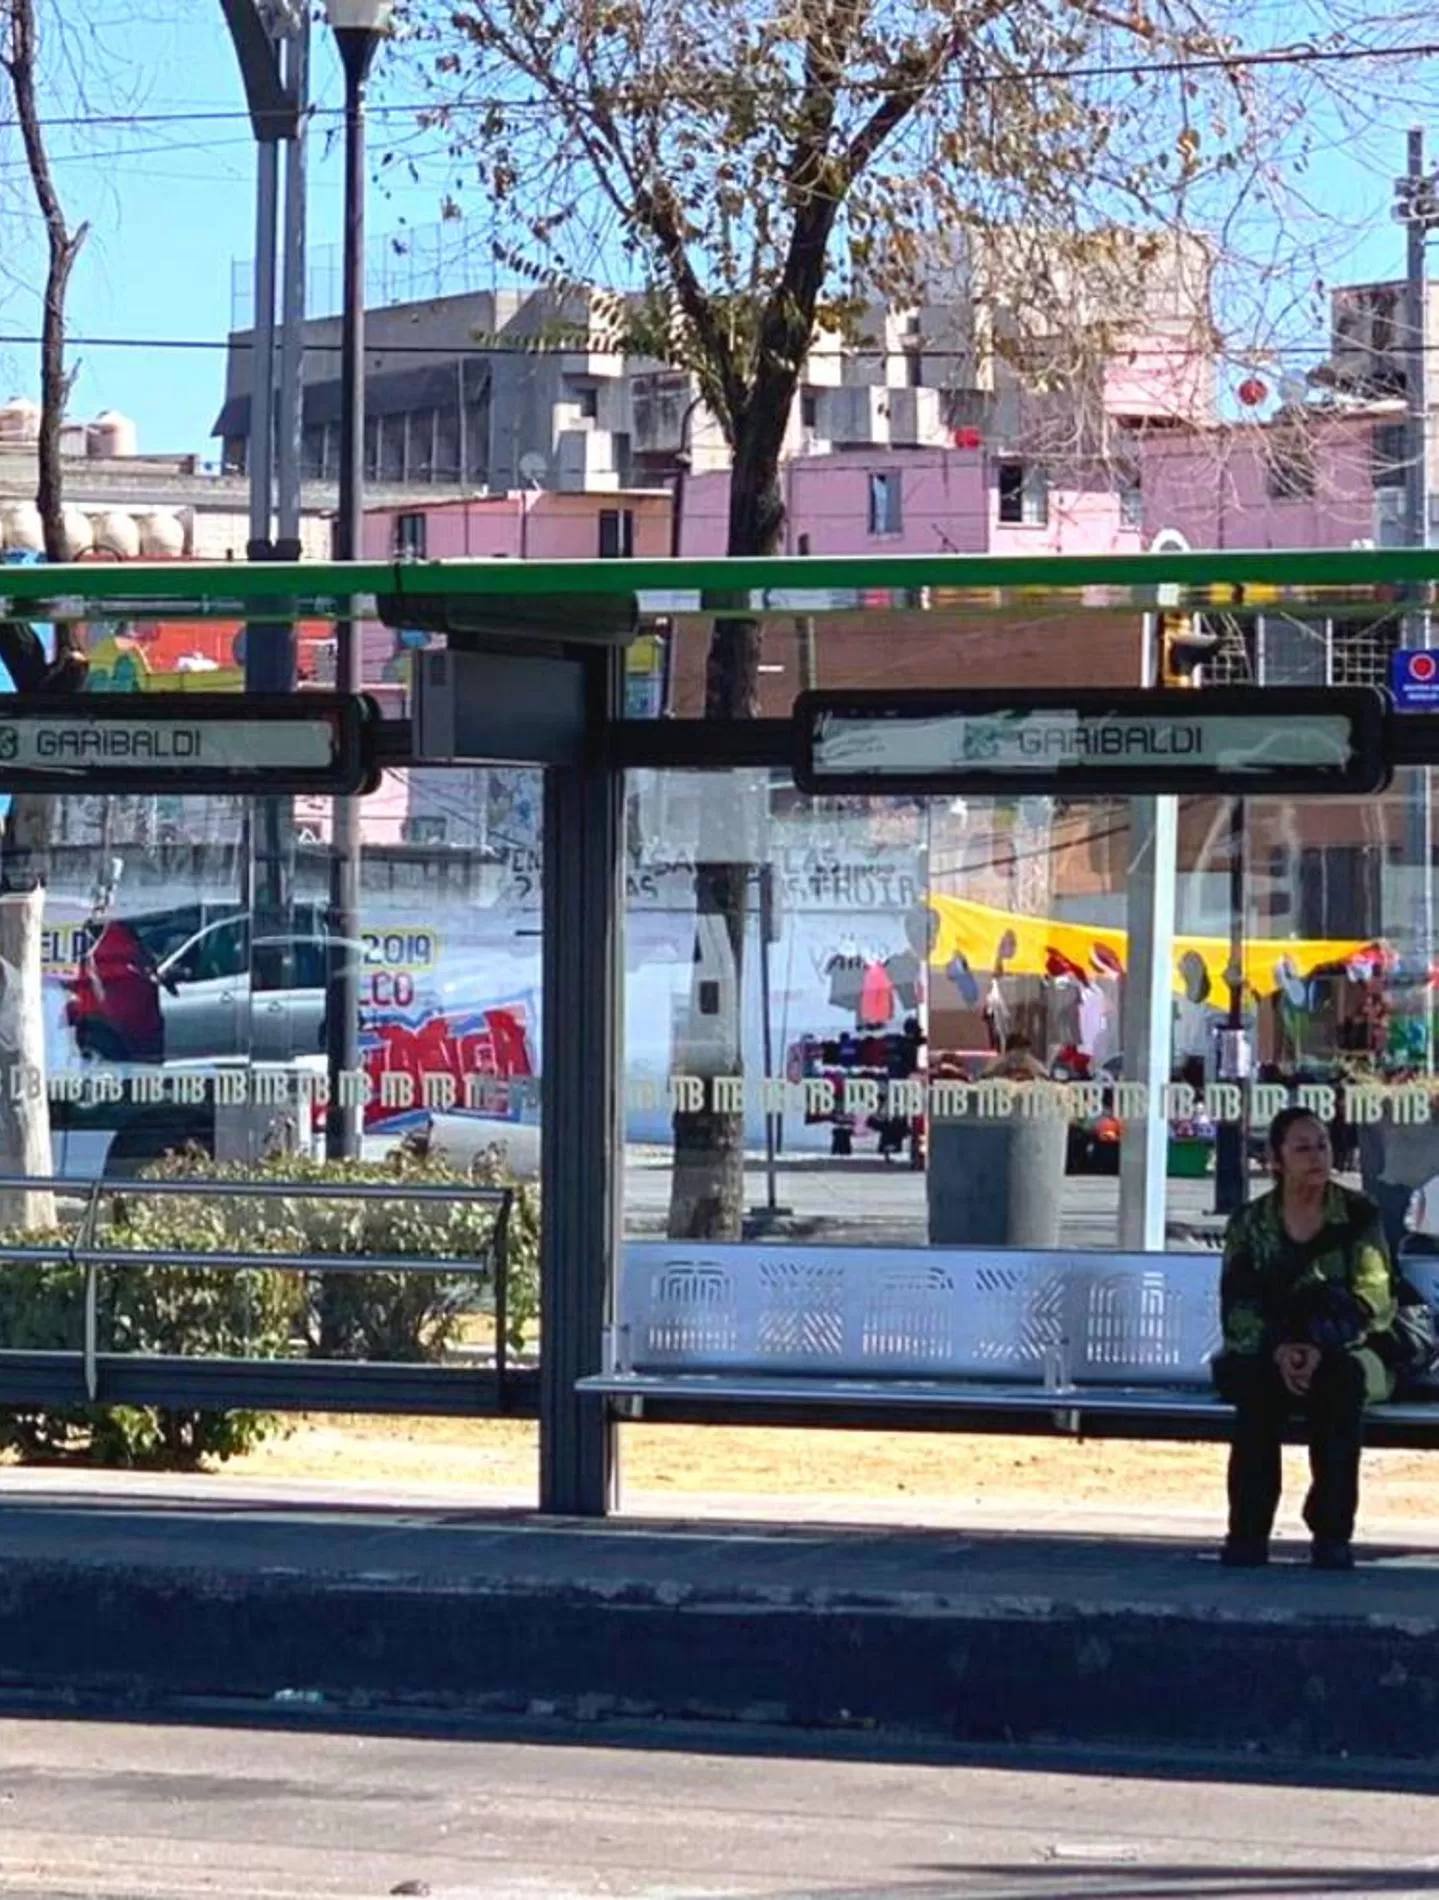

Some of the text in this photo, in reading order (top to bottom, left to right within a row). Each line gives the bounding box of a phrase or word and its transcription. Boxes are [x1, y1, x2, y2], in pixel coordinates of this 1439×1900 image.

[37, 729, 201, 757] GARIBALDI
[1020, 727, 1202, 754] GARIBALDI
[361, 933, 430, 965] 2019
